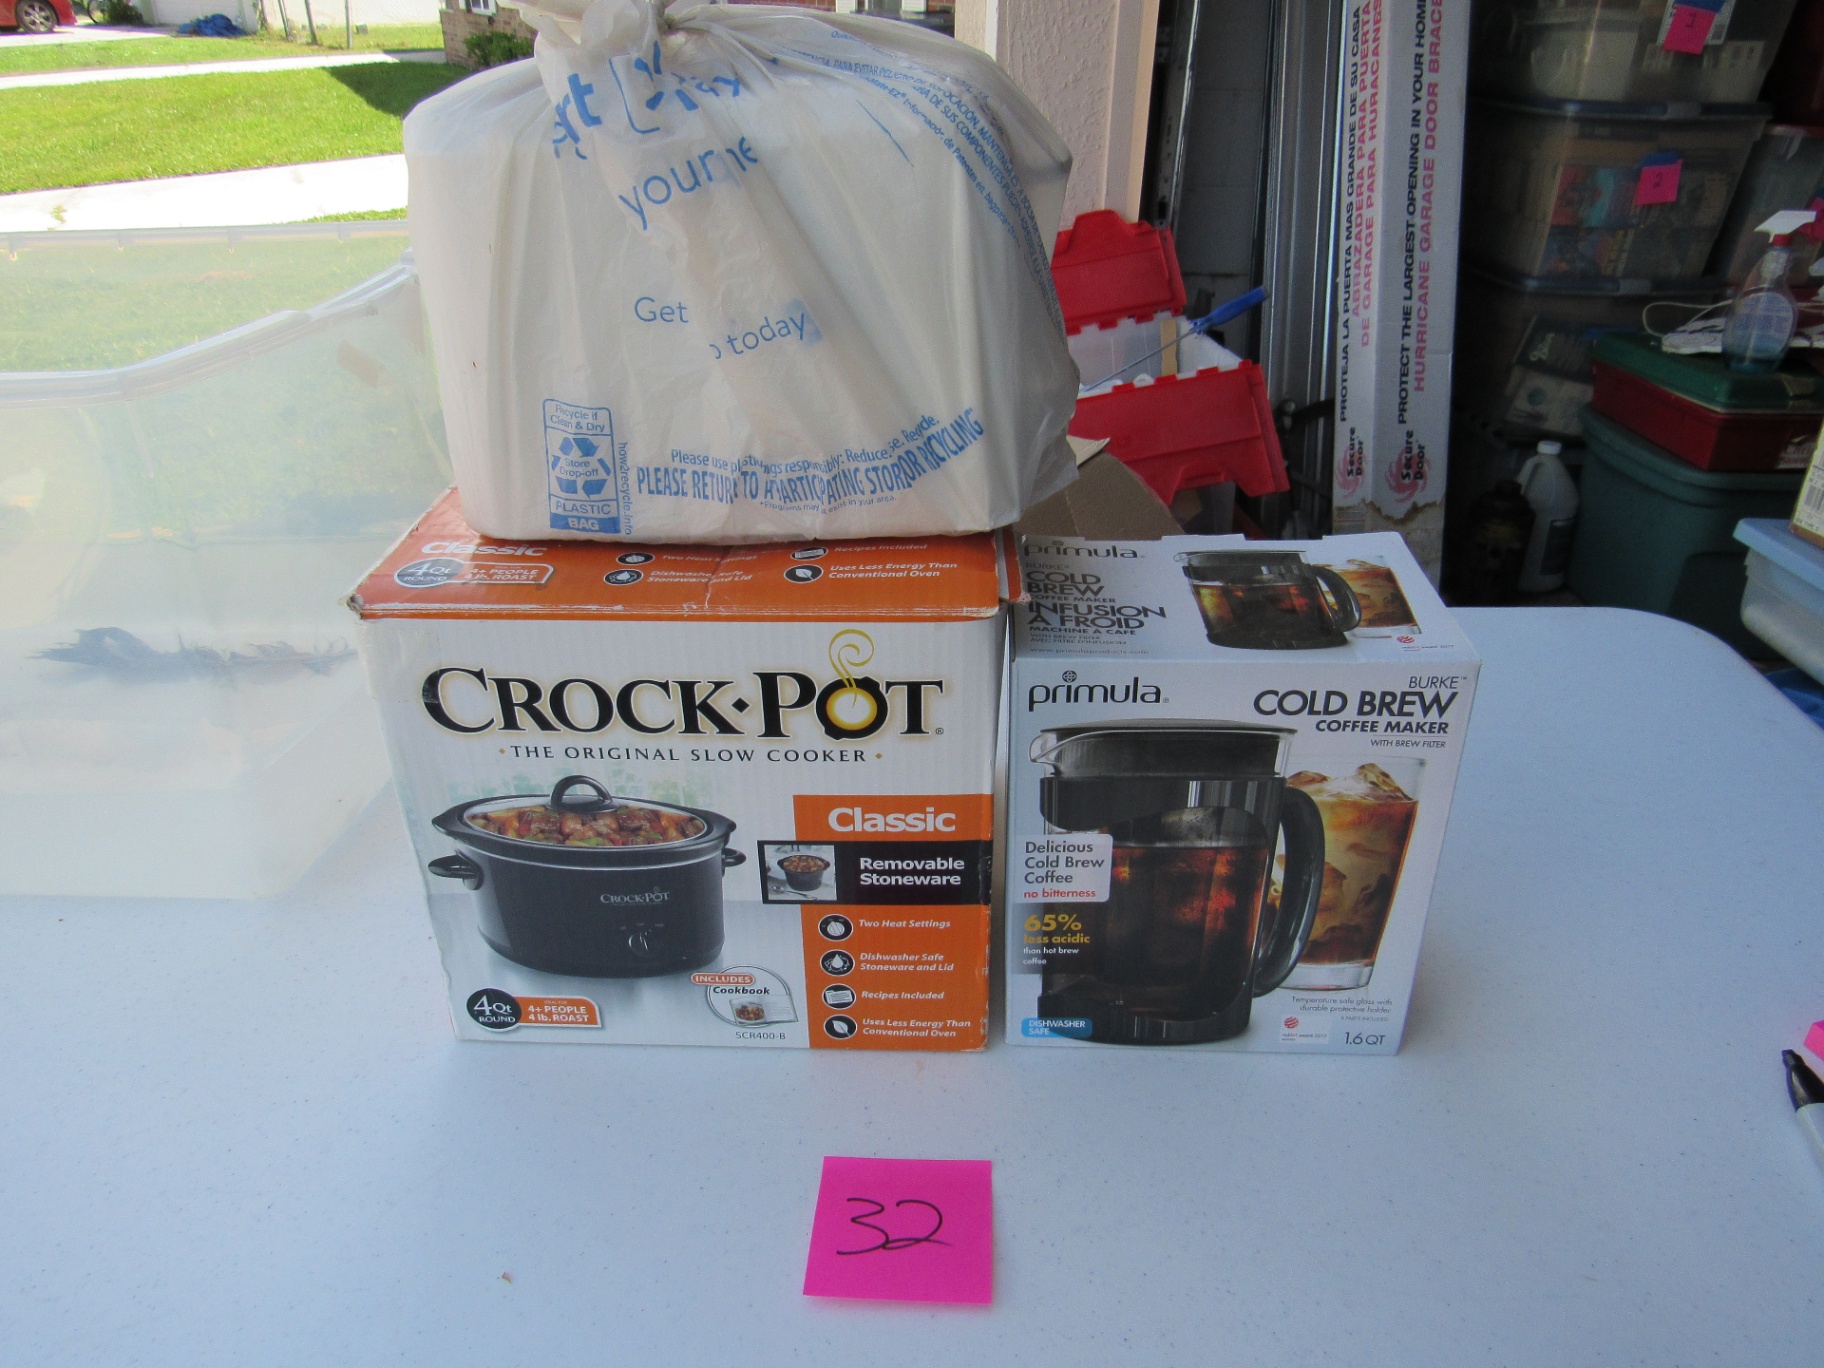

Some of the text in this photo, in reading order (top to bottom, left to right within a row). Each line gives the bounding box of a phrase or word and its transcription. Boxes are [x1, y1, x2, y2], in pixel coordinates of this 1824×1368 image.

[1412, 52, 1424, 105] YOUR
[1411, 109, 1421, 128] IN
[1424, 82, 1439, 150] DOOR
[1352, 0, 1371, 317] ABRAZADERA PARA PUERTA
[1365, 147, 1376, 210] PARA
[1407, 132, 1420, 216] OPENING
[619, 149, 715, 231] your
[1419, 158, 1435, 253] GARAGE
[1340, 5, 1360, 423] PROTEJA LA PUERTA MAS GRANDE DE SU CASA
[1362, 215, 1374, 312] GARAGE
[1404, 219, 1416, 300] LARGEST
[634, 296, 690, 324] Get
[1361, 317, 1370, 347] DE
[1402, 308, 1412, 343] THE
[1414, 260, 1430, 392] HURRICANE
[726, 311, 806, 357] today
[1398, 346, 1411, 424] PROTECT
[555, 404, 599, 420] Recycle if
[550, 414, 605, 434] Clean & Dry
[671, 449, 710, 466] Please
[711, 456, 728, 470] use
[1347, 426, 1356, 478] Secure
[1356, 439, 1364, 477] Door
[1401, 429, 1414, 481] Secure
[564, 457, 590, 468] Store
[1413, 443, 1425, 481] Door
[559, 466, 599, 478] Drop-off
[618, 441, 634, 535] how2recycle.info
[636, 466, 689, 497] PLEASE
[740, 470, 759, 500] TO
[555, 500, 611, 515] PLASTIC
[567, 517, 600, 531] BAG
[421, 541, 548, 557] Classic
[1025, 544, 1138, 559] primula
[489, 568, 540, 576] PEOPLE
[830, 561, 958, 572] Uses Less Energy Than
[828, 570, 941, 579] Conventional Oven
[1025, 571, 1101, 585] COLD
[1027, 583, 1104, 596] BREW
[1028, 602, 1167, 618] INFUSION
[1059, 614, 1145, 629] FROID
[1029, 625, 1089, 634] MACHINE
[1028, 676, 1162, 712] primula
[1253, 690, 1459, 718] COLD BREW
[1315, 719, 1449, 735] COFFEE MAKER
[1370, 738, 1446, 749] WITH BREW FILTER
[509, 745, 867, 763] THE ORIGINAL SLOW COOKER
[828, 807, 956, 832] Classic
[1025, 841, 1094, 854] Delicious
[859, 857, 965, 870] Removable
[1024, 856, 1105, 869] Cold Brew
[859, 873, 962, 886] Stoneware
[1024, 871, 1074, 884] Coffee
[1023, 888, 1097, 899] no bitterness
[859, 919, 951, 930] Two Heat Settings
[1023, 913, 1083, 932] 65%
[1023, 933, 1091, 944] less acidic
[859, 952, 944, 962] Dishwasher Safe
[1023, 947, 1080, 955] than hot brew
[859, 962, 955, 972] Stoneware and Lid
[1023, 957, 1047, 965] coffee
[695, 975, 751, 984] INCLUDES
[713, 986, 770, 996] Cookbook
[861, 990, 945, 1000] Recipes Included
[1292, 996, 1393, 1006] Temperature safe glass with
[528, 1005, 587, 1014] 4+ PEOPLE
[1299, 1004, 1391, 1014] durable protective holder
[478, 1015, 516, 1023] ROUND
[553, 1014, 589, 1022] ROAST
[862, 1018, 971, 1029] Uses Less Energy Than
[1028, 1019, 1086, 1028] DISHWASHER
[735, 1031, 787, 1041] SCR400-B
[862, 1027, 957, 1037] Conventional Oven
[1028, 1027, 1050, 1036] SAFE
[836, 1197, 952, 1255] 32
